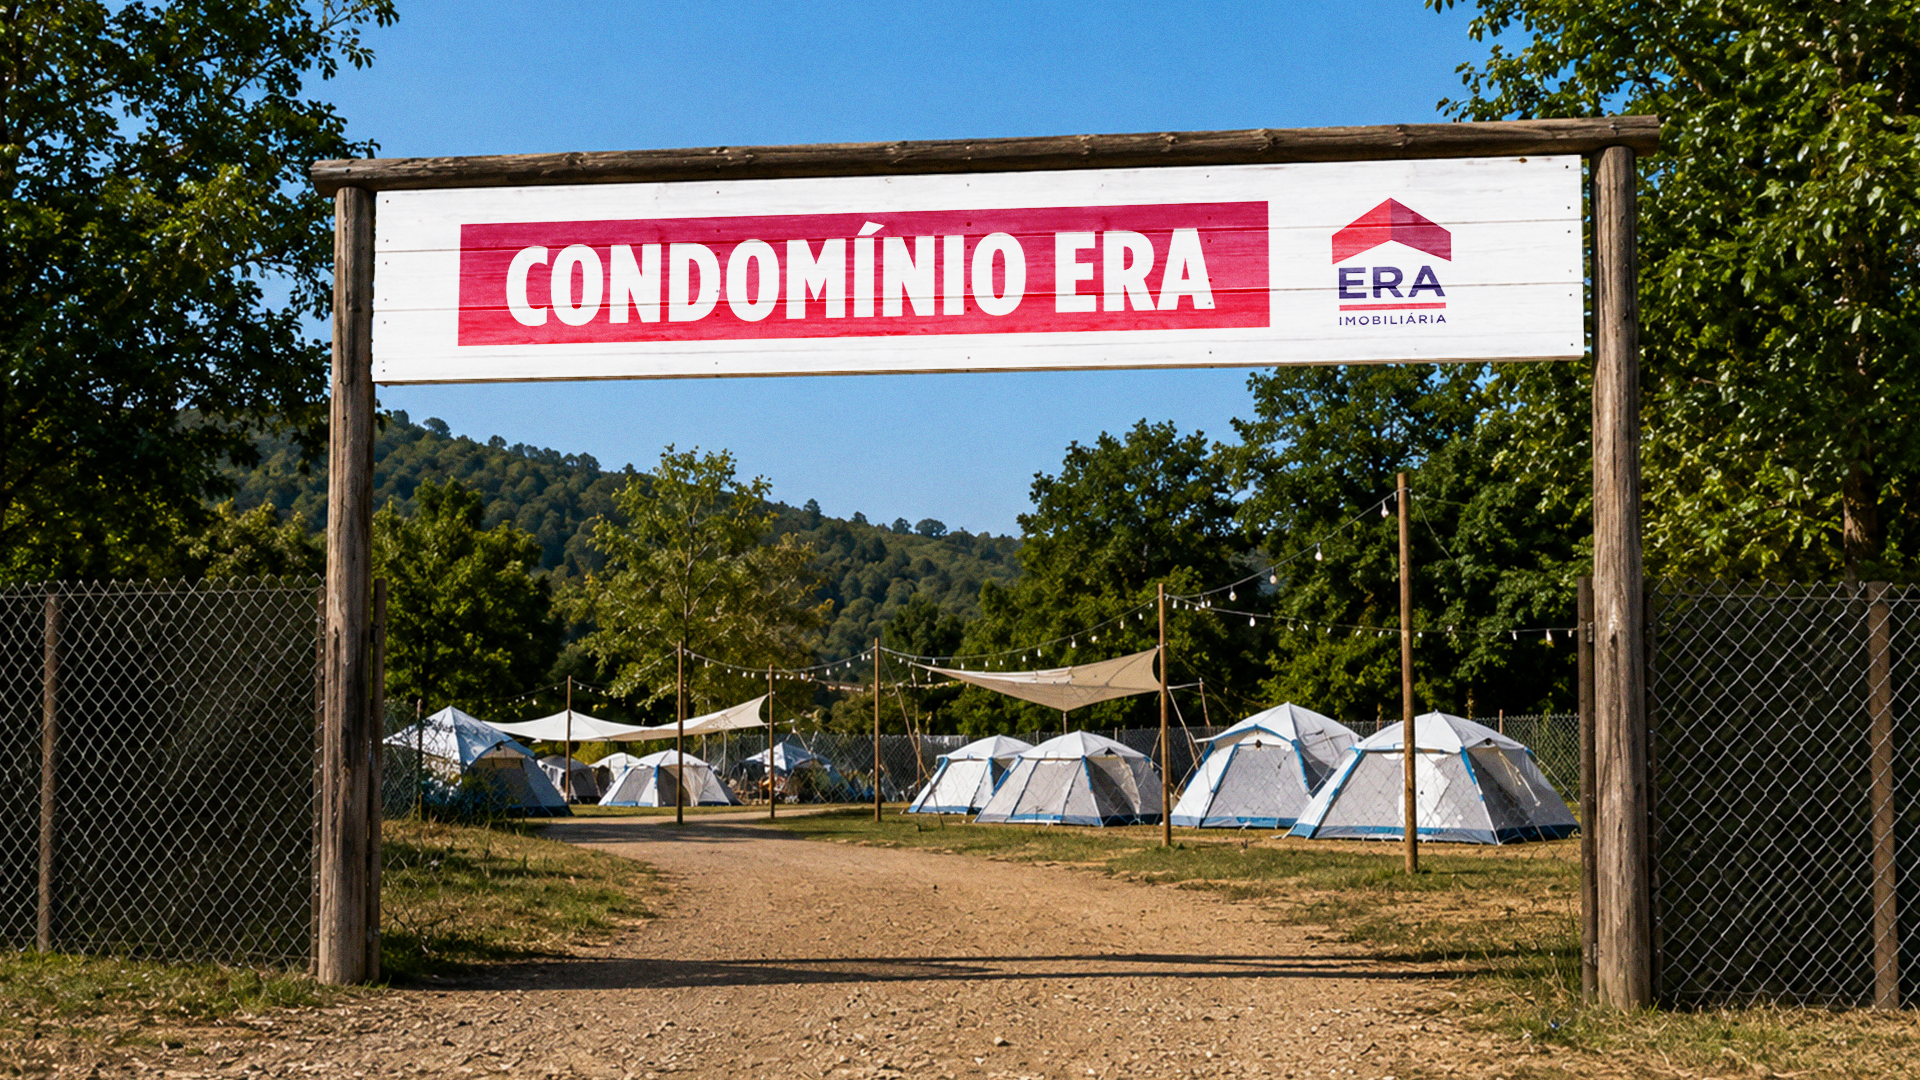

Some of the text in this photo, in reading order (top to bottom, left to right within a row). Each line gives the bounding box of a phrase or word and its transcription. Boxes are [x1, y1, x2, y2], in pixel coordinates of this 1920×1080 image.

[506, 221, 1216, 327] CONDOMÍNIO ERA
[1338, 265, 1446, 299] ERA
[1338, 312, 1447, 326] IMOBILIÁRIA
